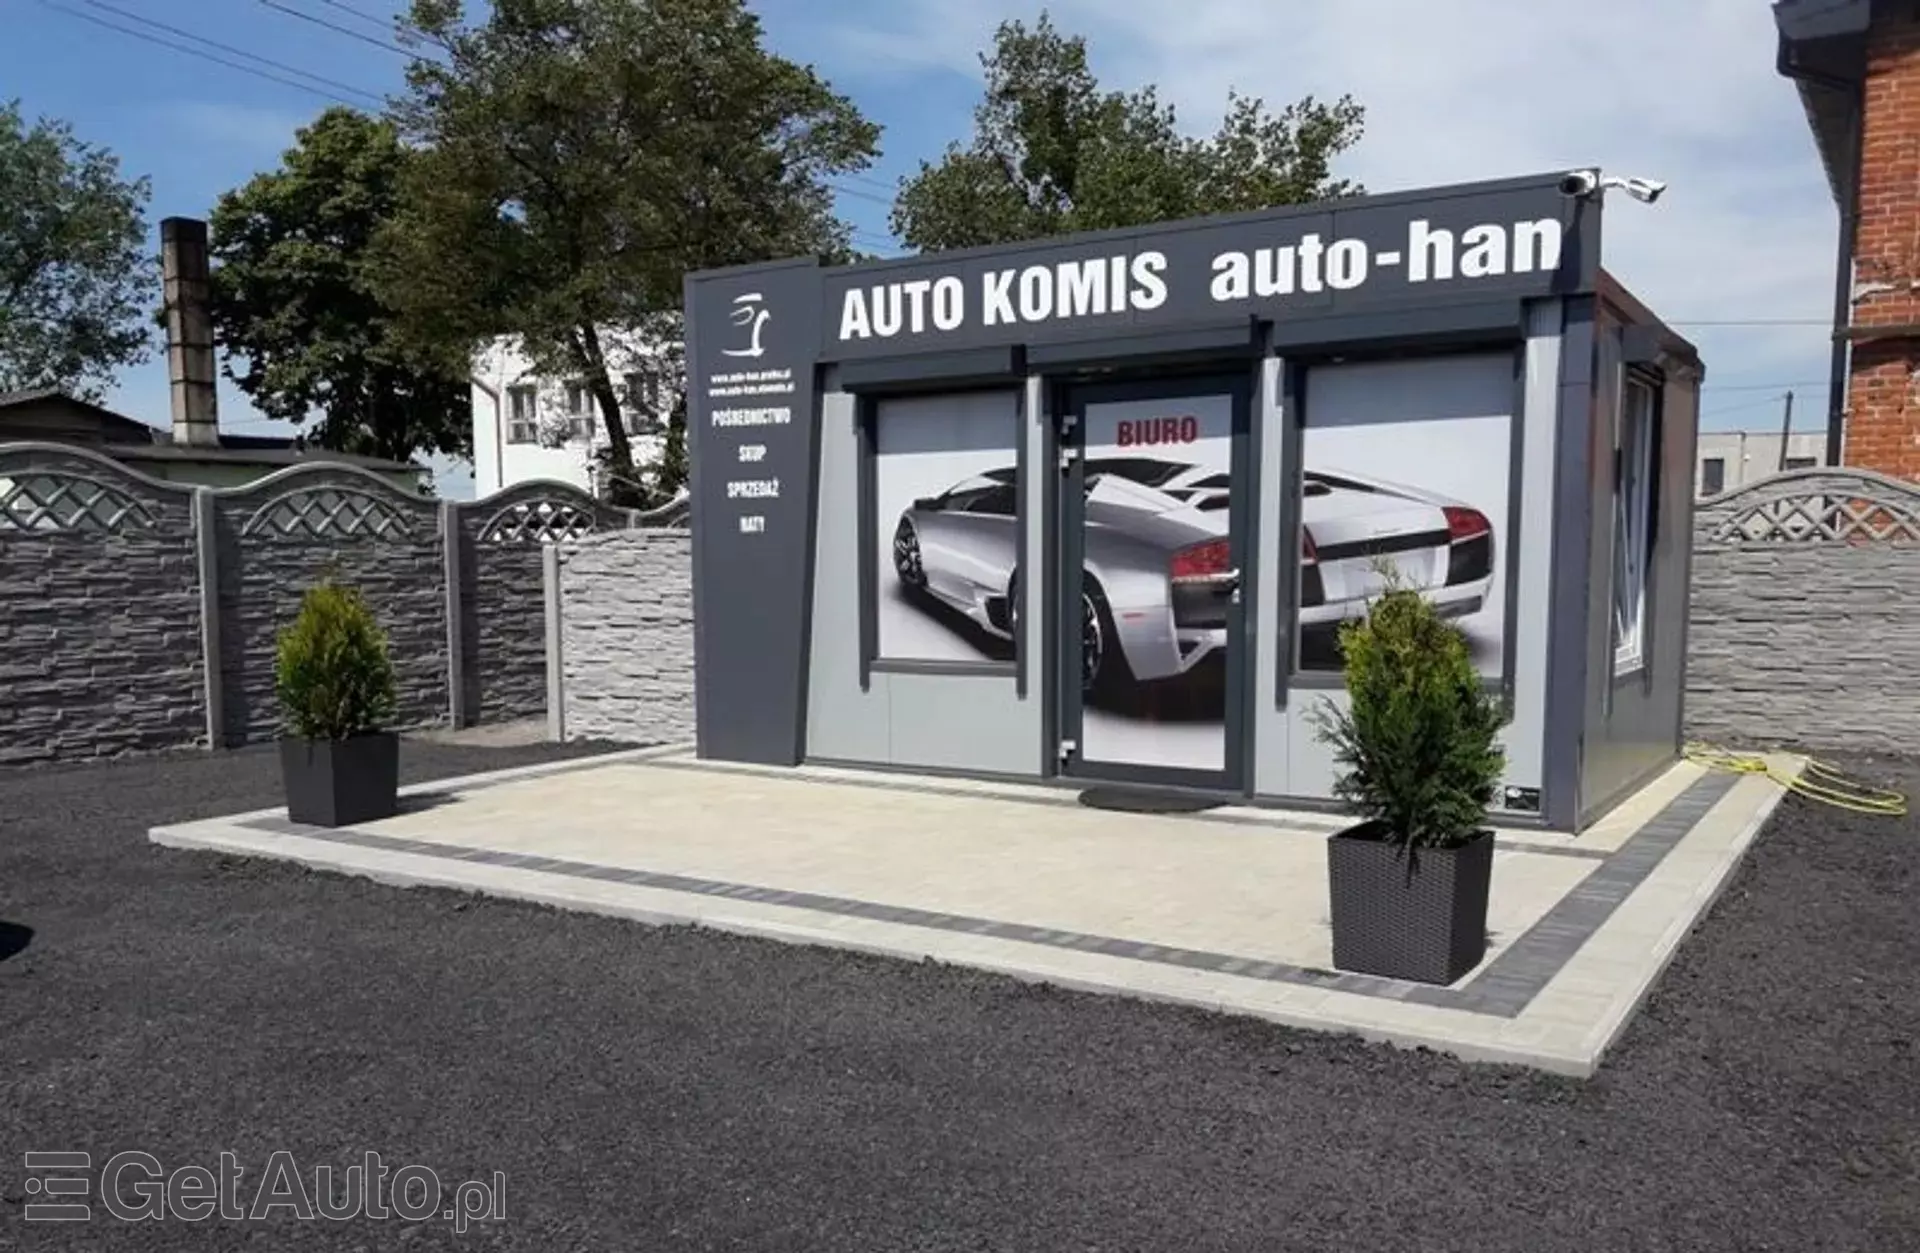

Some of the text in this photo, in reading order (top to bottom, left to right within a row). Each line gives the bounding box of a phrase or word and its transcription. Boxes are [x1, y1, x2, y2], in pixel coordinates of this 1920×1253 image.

[839, 217, 1563, 340] AUTO KOMIS auto-han
[1117, 415, 1198, 447] BIURO
[727, 475, 780, 498] SPRZEDAŻ
